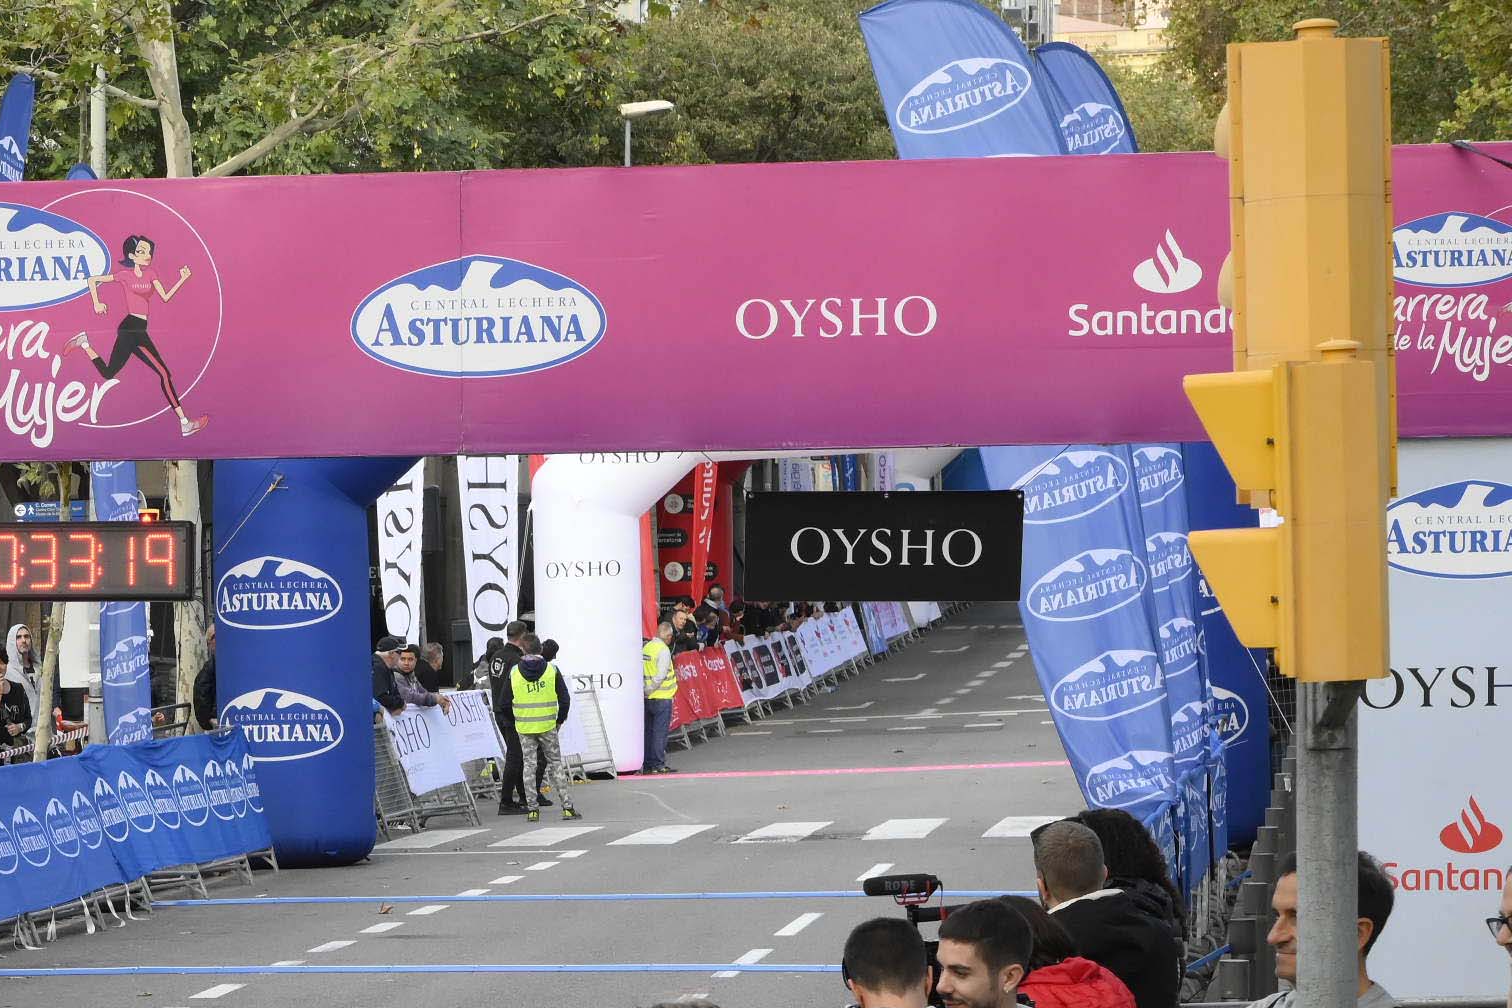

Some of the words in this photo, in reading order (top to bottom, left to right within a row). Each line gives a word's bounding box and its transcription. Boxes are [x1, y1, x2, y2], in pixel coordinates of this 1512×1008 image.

[13, 239, 85, 250] LECHERA
[1408, 237, 1459, 246] CENTRAL
[1464, 236, 1512, 246] LECHER
[410, 298, 488, 311] CENTRAL
[497, 297, 577, 308] LECHERA
[371, 302, 587, 347] ASTURIANA
[735, 296, 938, 340] OYSHO
[1417, 322, 1435, 351] la
[1414, 515, 1482, 525] CENTRAL
[791, 527, 982, 567] OYSHO
[546, 560, 621, 579] OYSHO
[233, 582, 275, 590] CENTRAL
[280, 581, 329, 590] LECHERA
[220, 586, 334, 613] ASTURIANA
[527, 680, 546, 693] Life
[234, 713, 275, 721] CENTRAL
[281, 713, 329, 721] LECHERA
